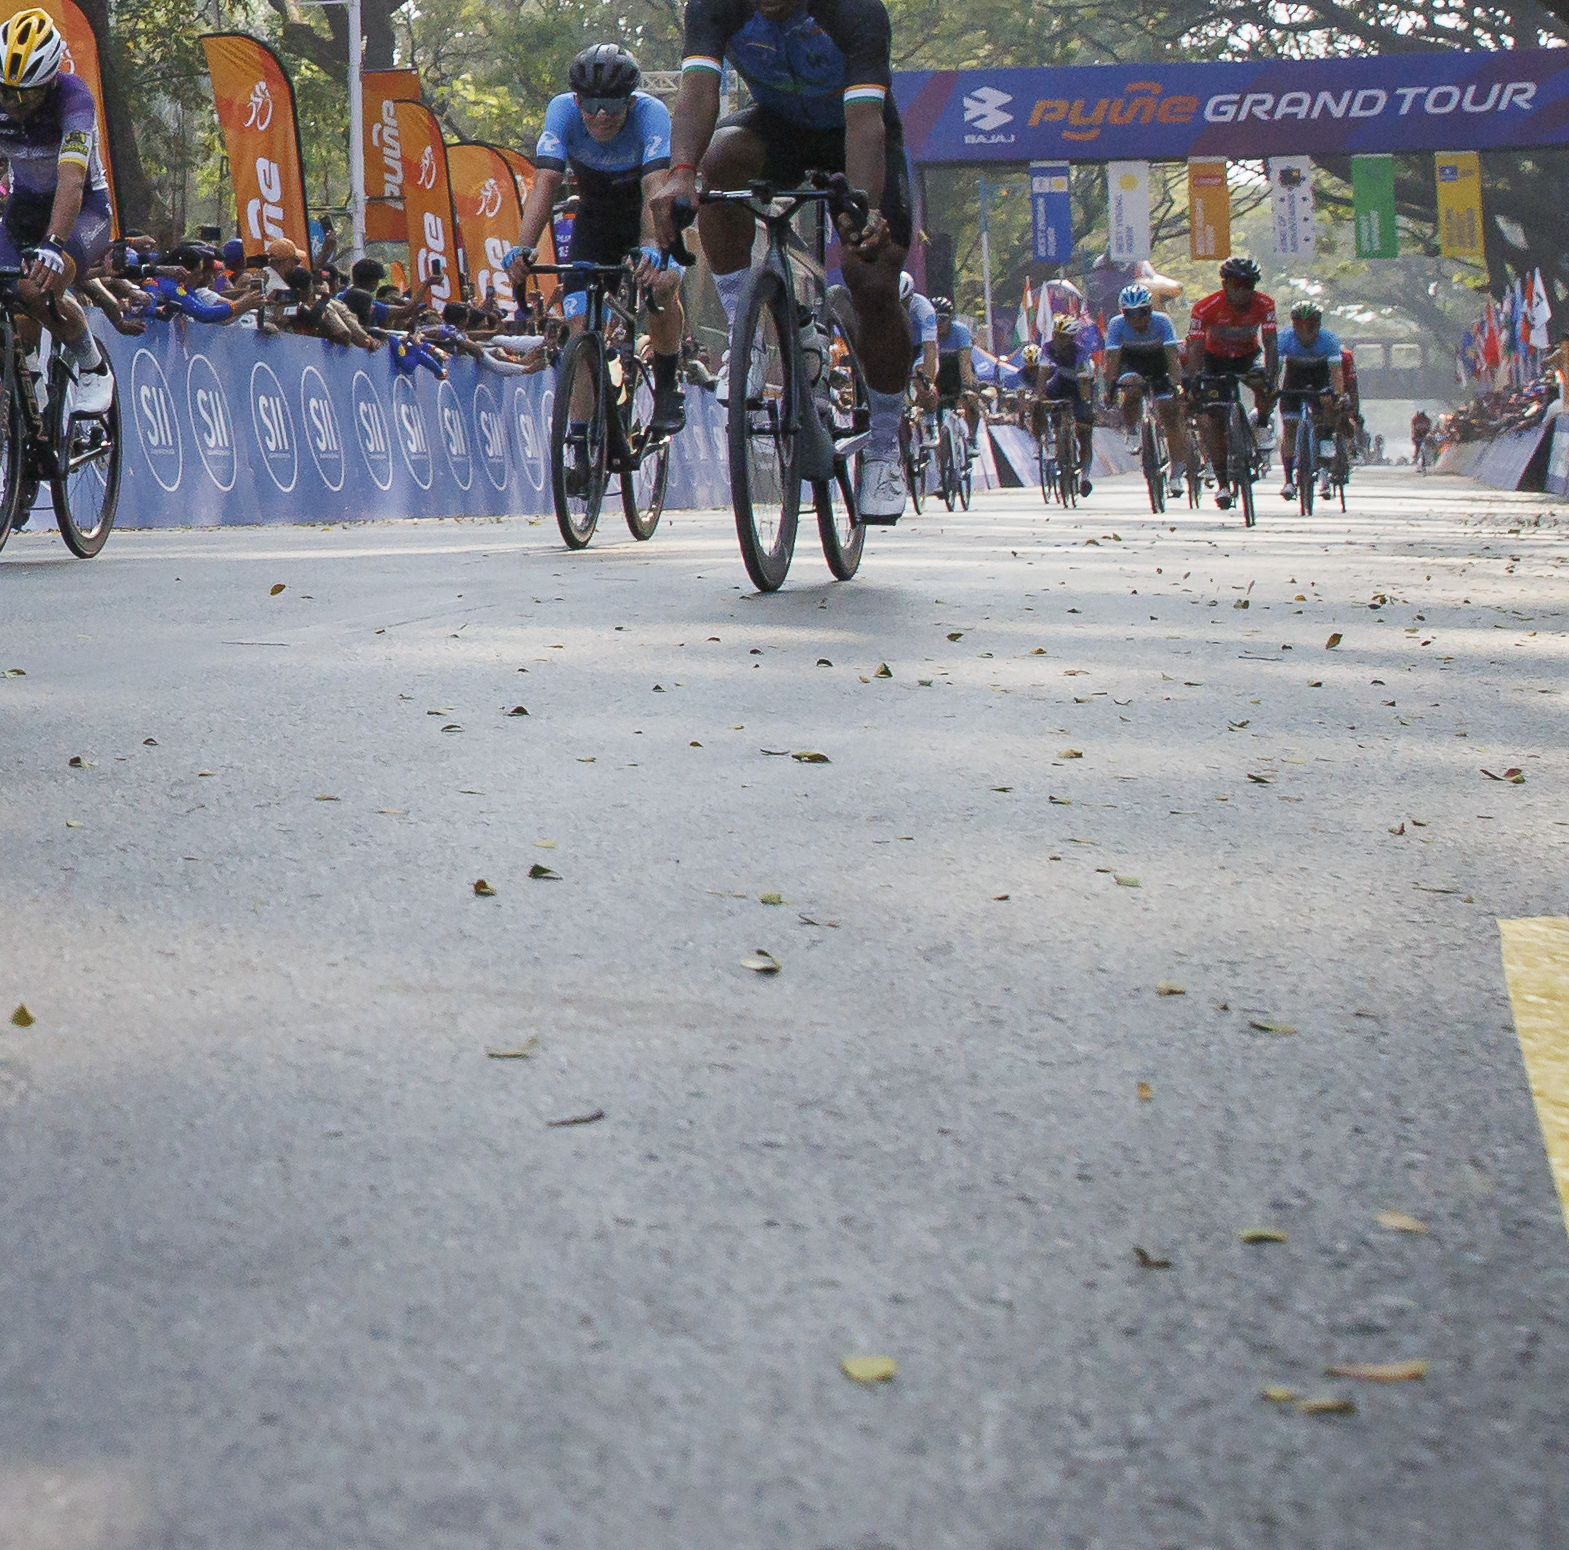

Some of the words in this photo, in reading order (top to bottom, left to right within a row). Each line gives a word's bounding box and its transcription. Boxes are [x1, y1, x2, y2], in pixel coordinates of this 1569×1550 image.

[1203, 86, 1386, 122] GRAND
[1392, 81, 1538, 116] TOUR
[965, 134, 1015, 143] BAJAJ
[141, 385, 173, 446] SII
[197, 388, 229, 448] SII
[259, 394, 289, 451] SII
[310, 397, 339, 451] SII
[359, 402, 386, 452] SII
